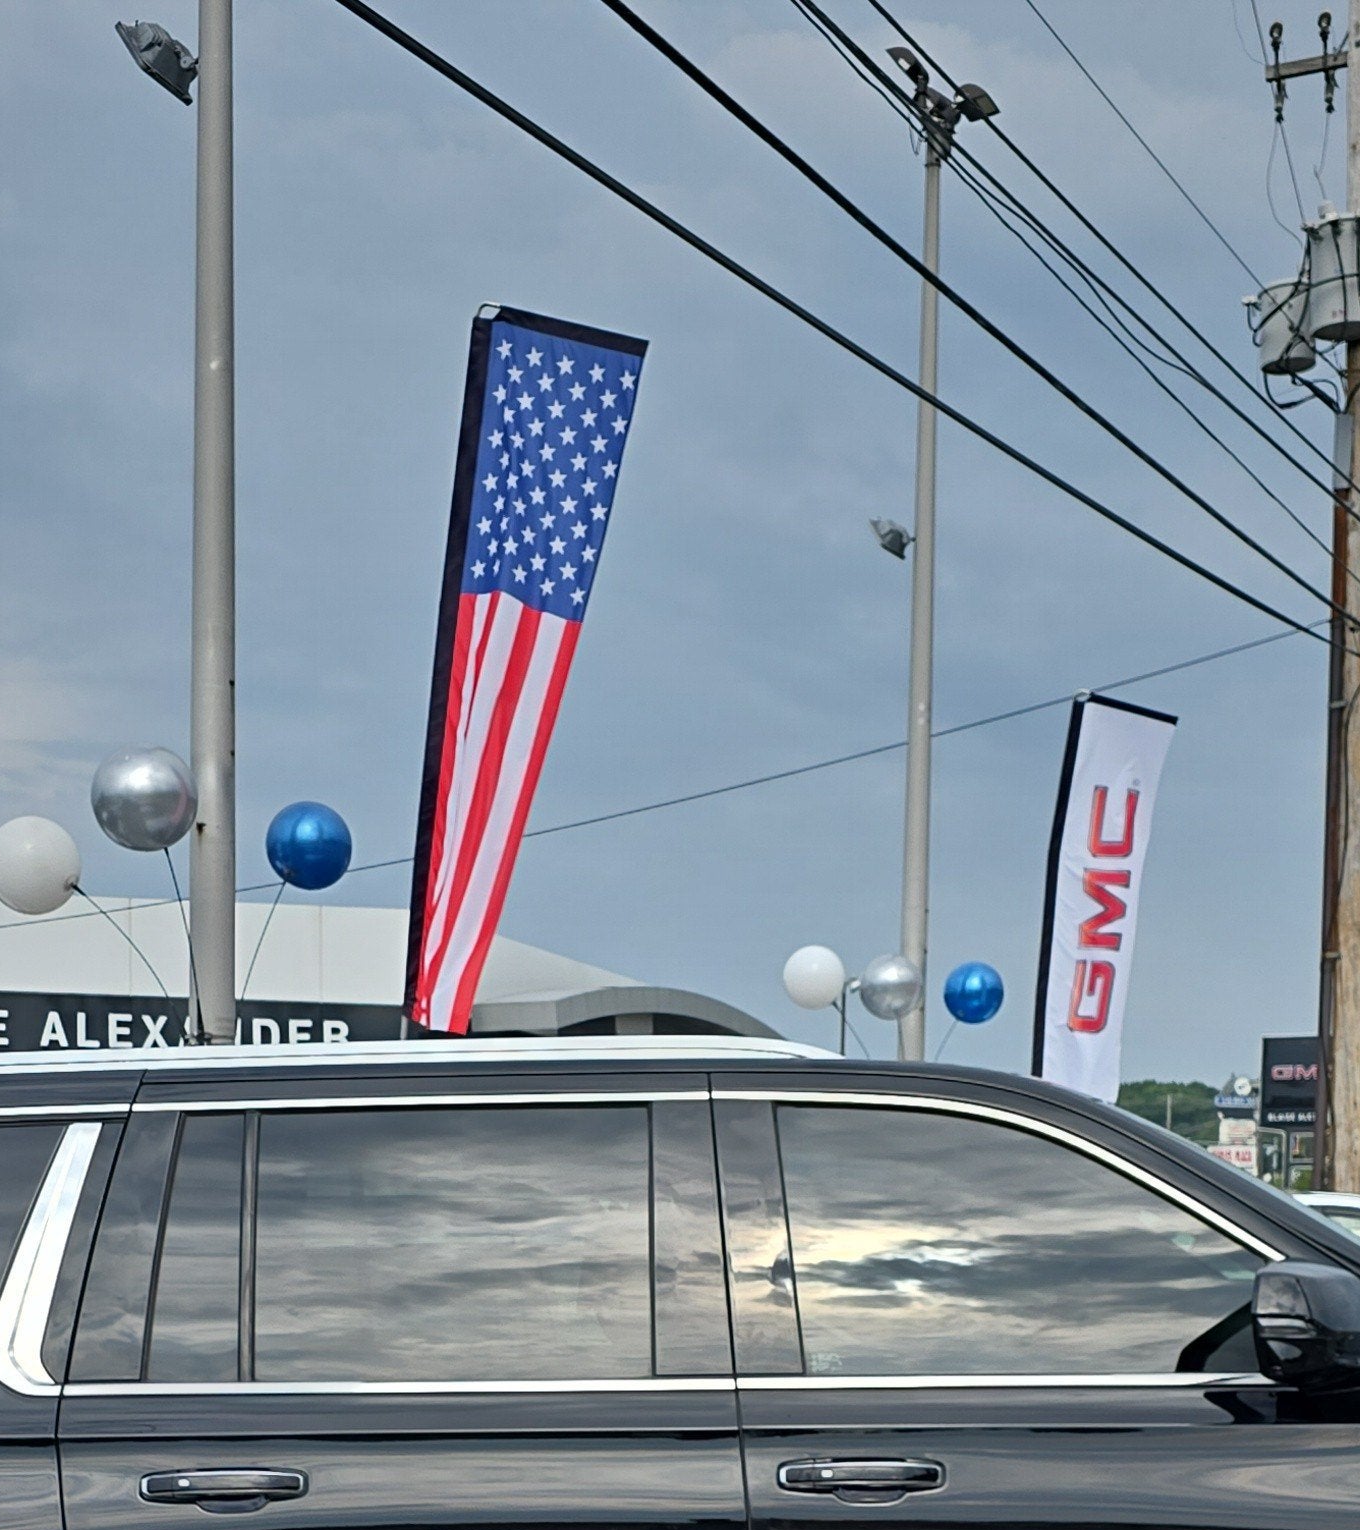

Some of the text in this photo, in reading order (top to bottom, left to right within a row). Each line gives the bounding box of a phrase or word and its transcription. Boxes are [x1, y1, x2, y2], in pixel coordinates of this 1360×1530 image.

[1066, 785, 1140, 1034] GMC
[40, 1010, 350, 1049] ALEXDER
[1271, 1064, 1320, 1081] GM
